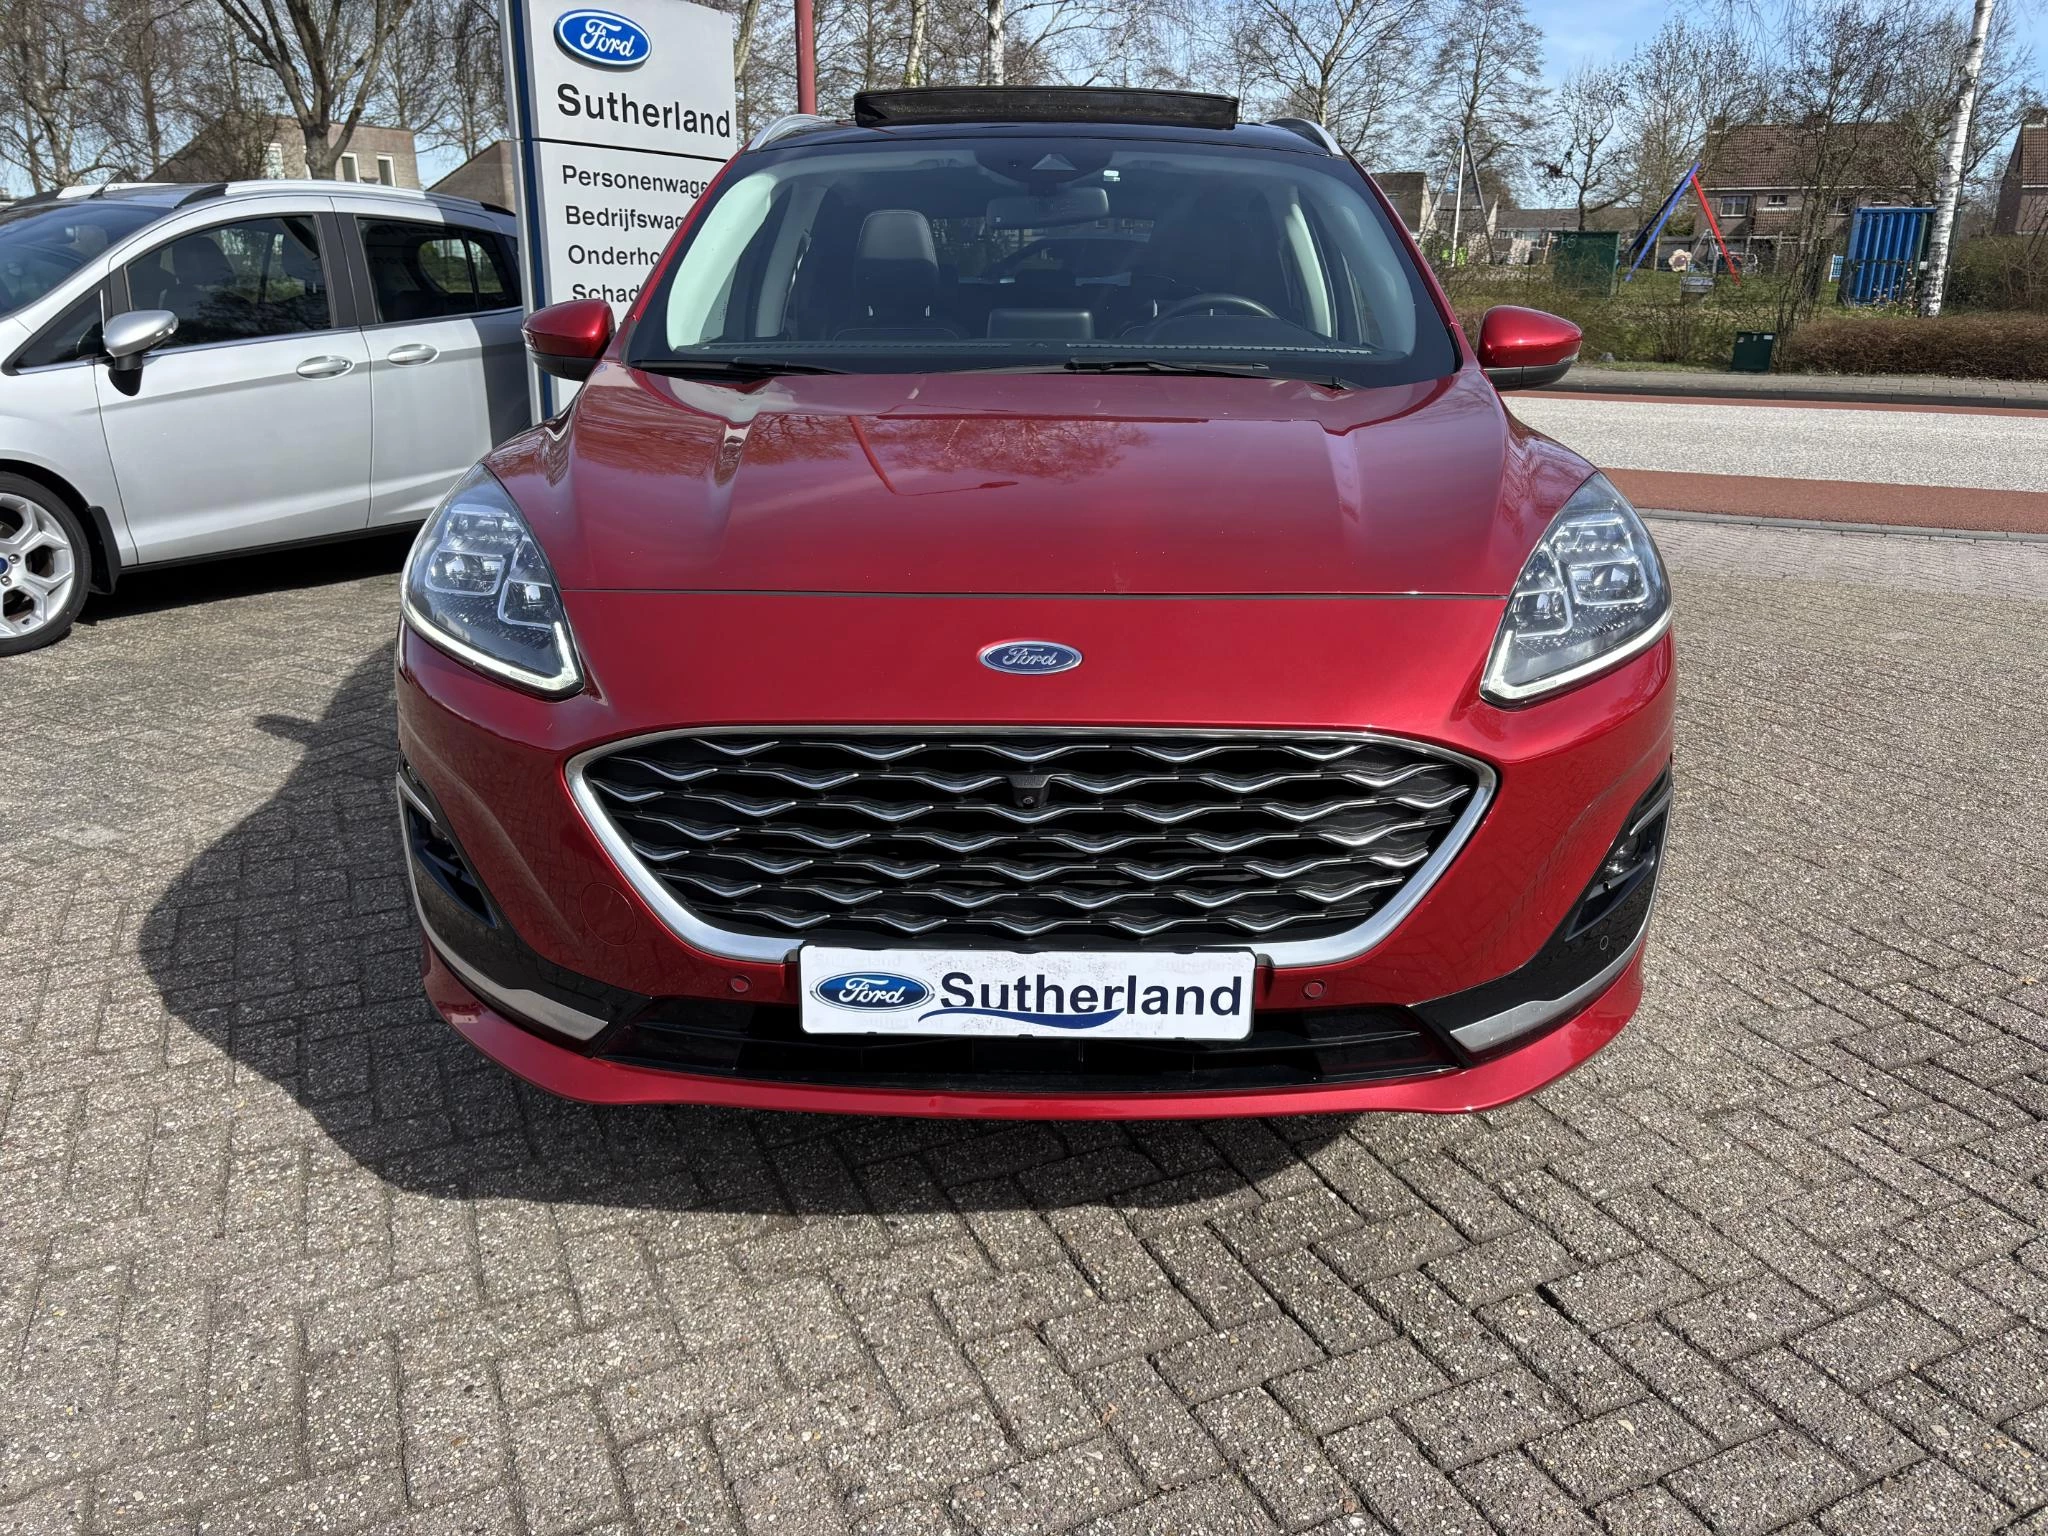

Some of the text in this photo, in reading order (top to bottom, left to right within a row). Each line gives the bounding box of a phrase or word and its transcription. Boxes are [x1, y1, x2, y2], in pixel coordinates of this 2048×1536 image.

[580, 19, 634, 57] Ford
[557, 84, 730, 138] Sutherland
[1002, 647, 1057, 666] Ford
[838, 972, 1242, 1015] Ford Sutherland
